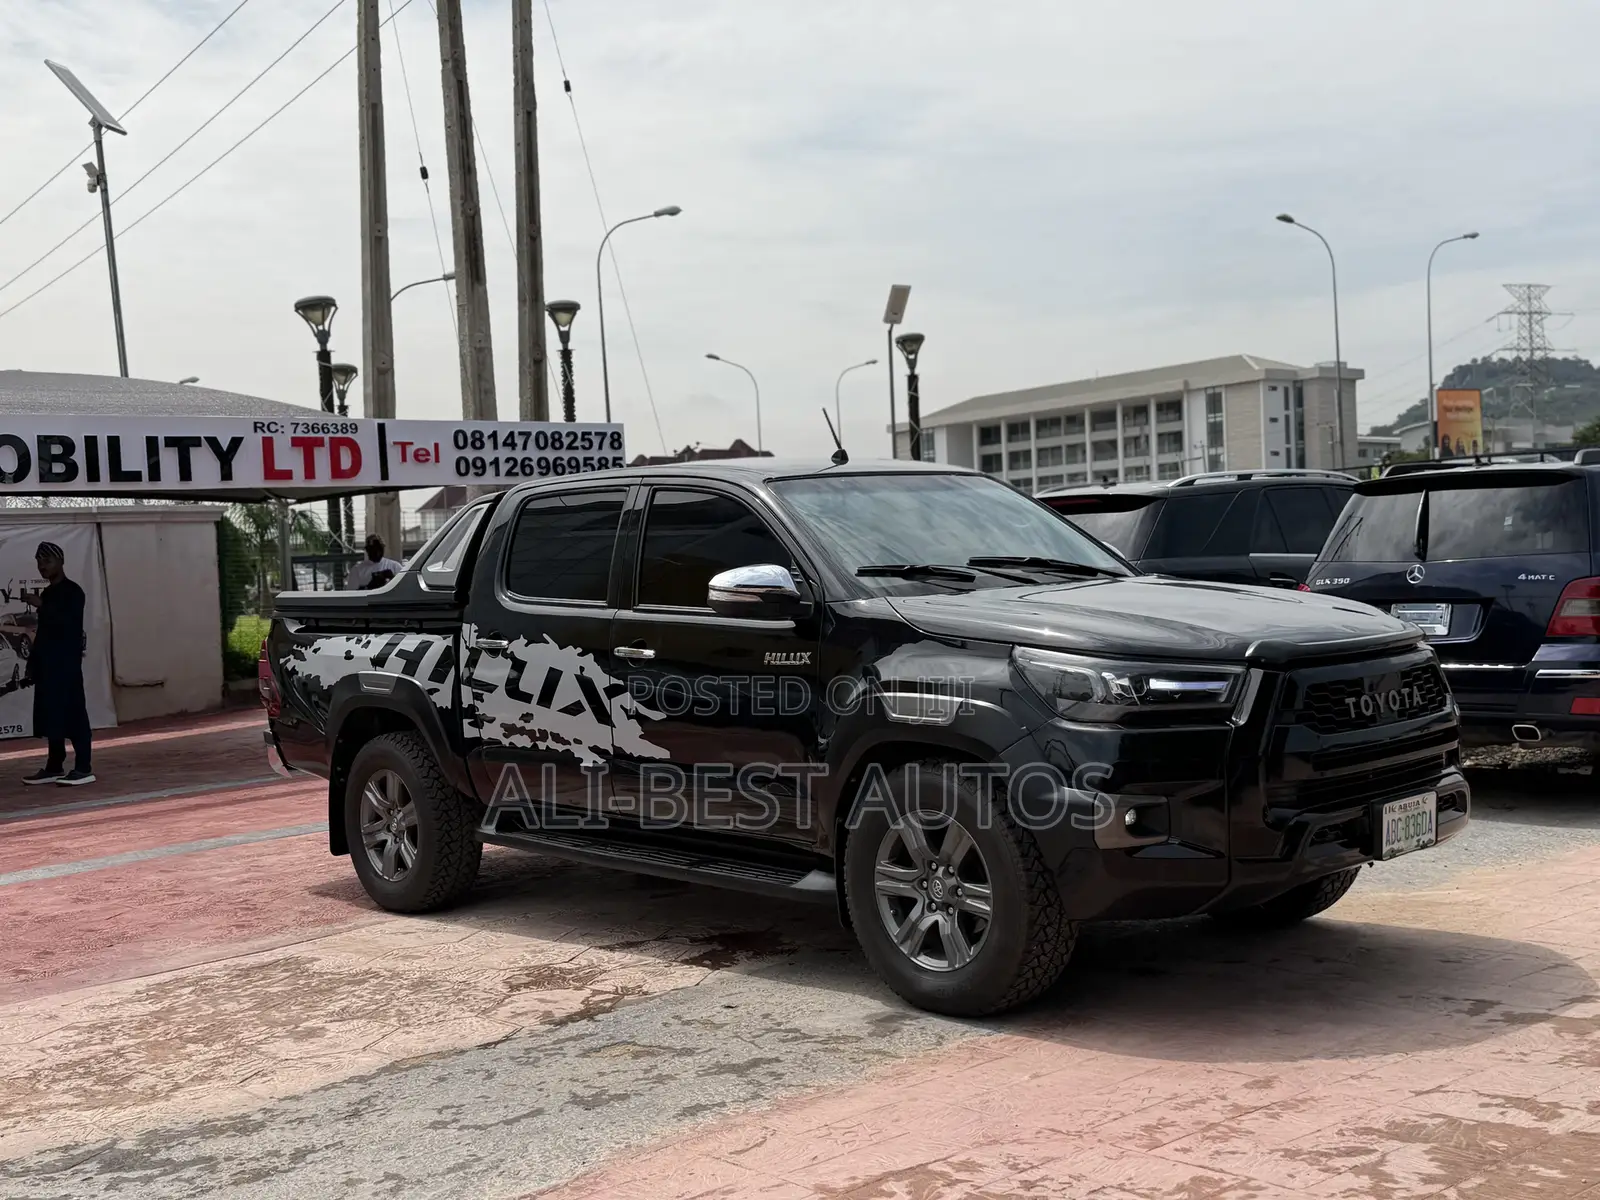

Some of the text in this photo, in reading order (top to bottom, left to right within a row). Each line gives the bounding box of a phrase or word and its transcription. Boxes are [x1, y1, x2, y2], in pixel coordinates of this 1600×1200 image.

[253, 421, 359, 435] RC: 7366389
[453, 429, 623, 451] 08147082578
[262, 436, 362, 481] LTD
[392, 441, 440, 464] Tel
[1517, 573, 1555, 581] 4MATC
[763, 651, 812, 666] HILUX
[1344, 685, 1424, 719] TOYOTA
